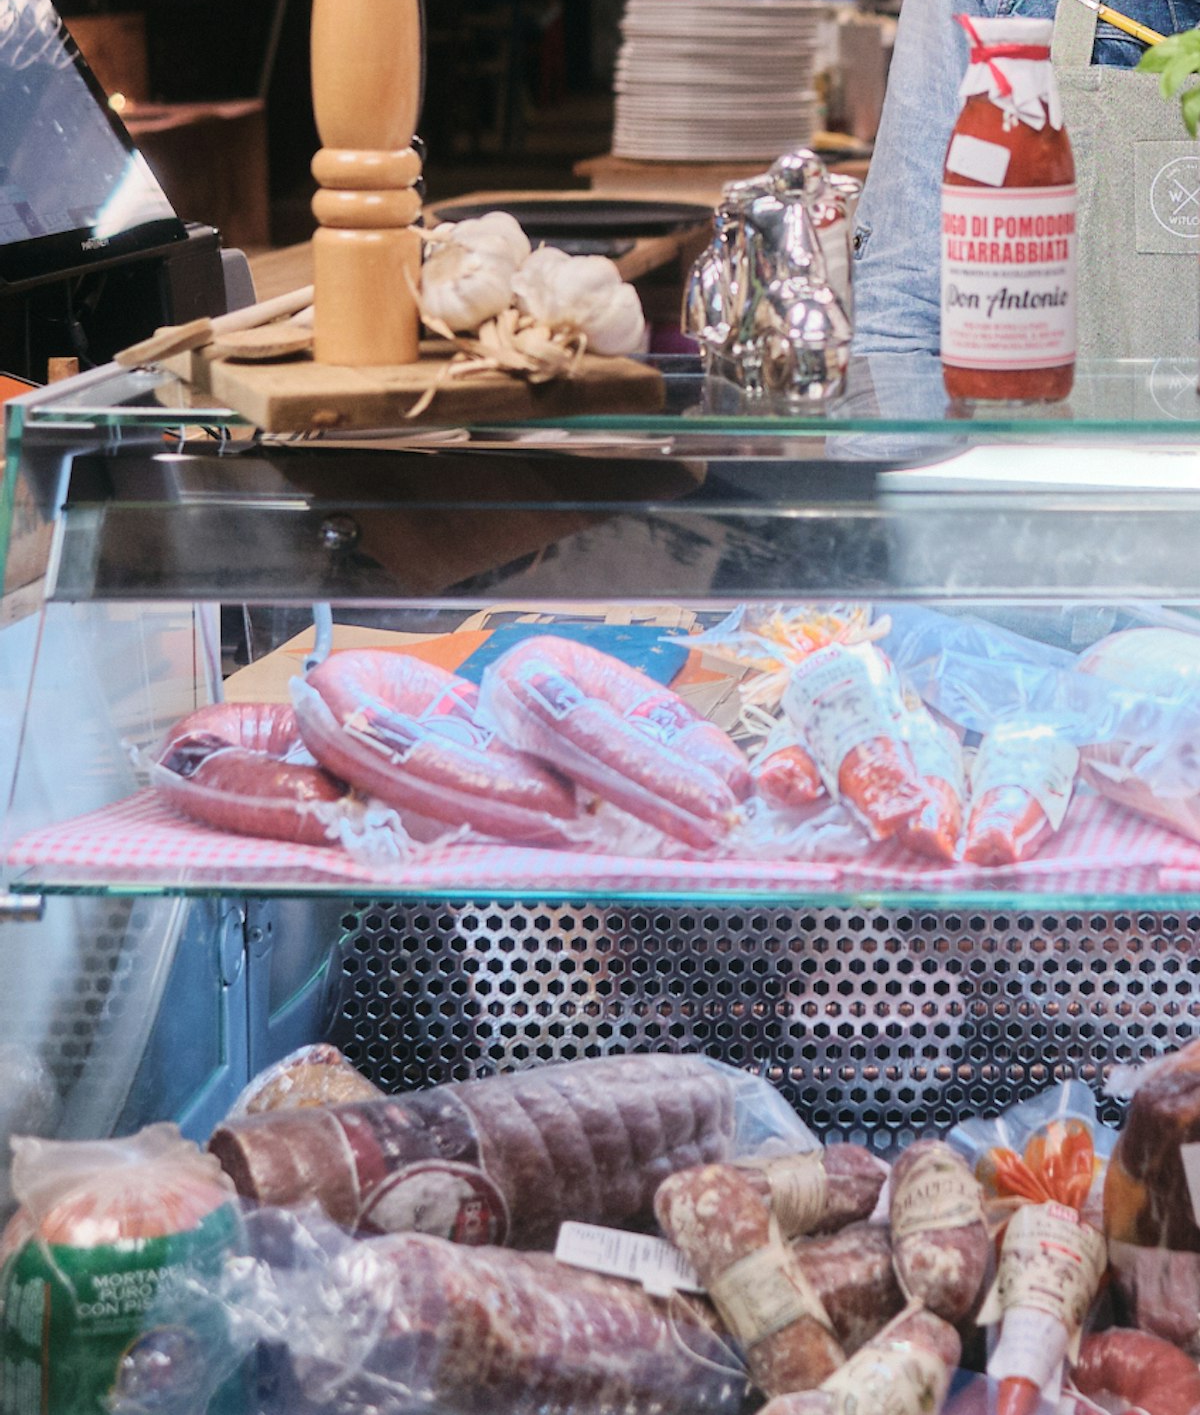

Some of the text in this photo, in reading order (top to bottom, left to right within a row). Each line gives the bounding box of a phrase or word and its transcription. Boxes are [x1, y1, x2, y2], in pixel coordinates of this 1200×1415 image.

[1168, 189, 1184, 203] W
[971, 215, 988, 237] DI
[1168, 214, 1200, 227] WITLO
[77, 1300, 119, 1318] CON
